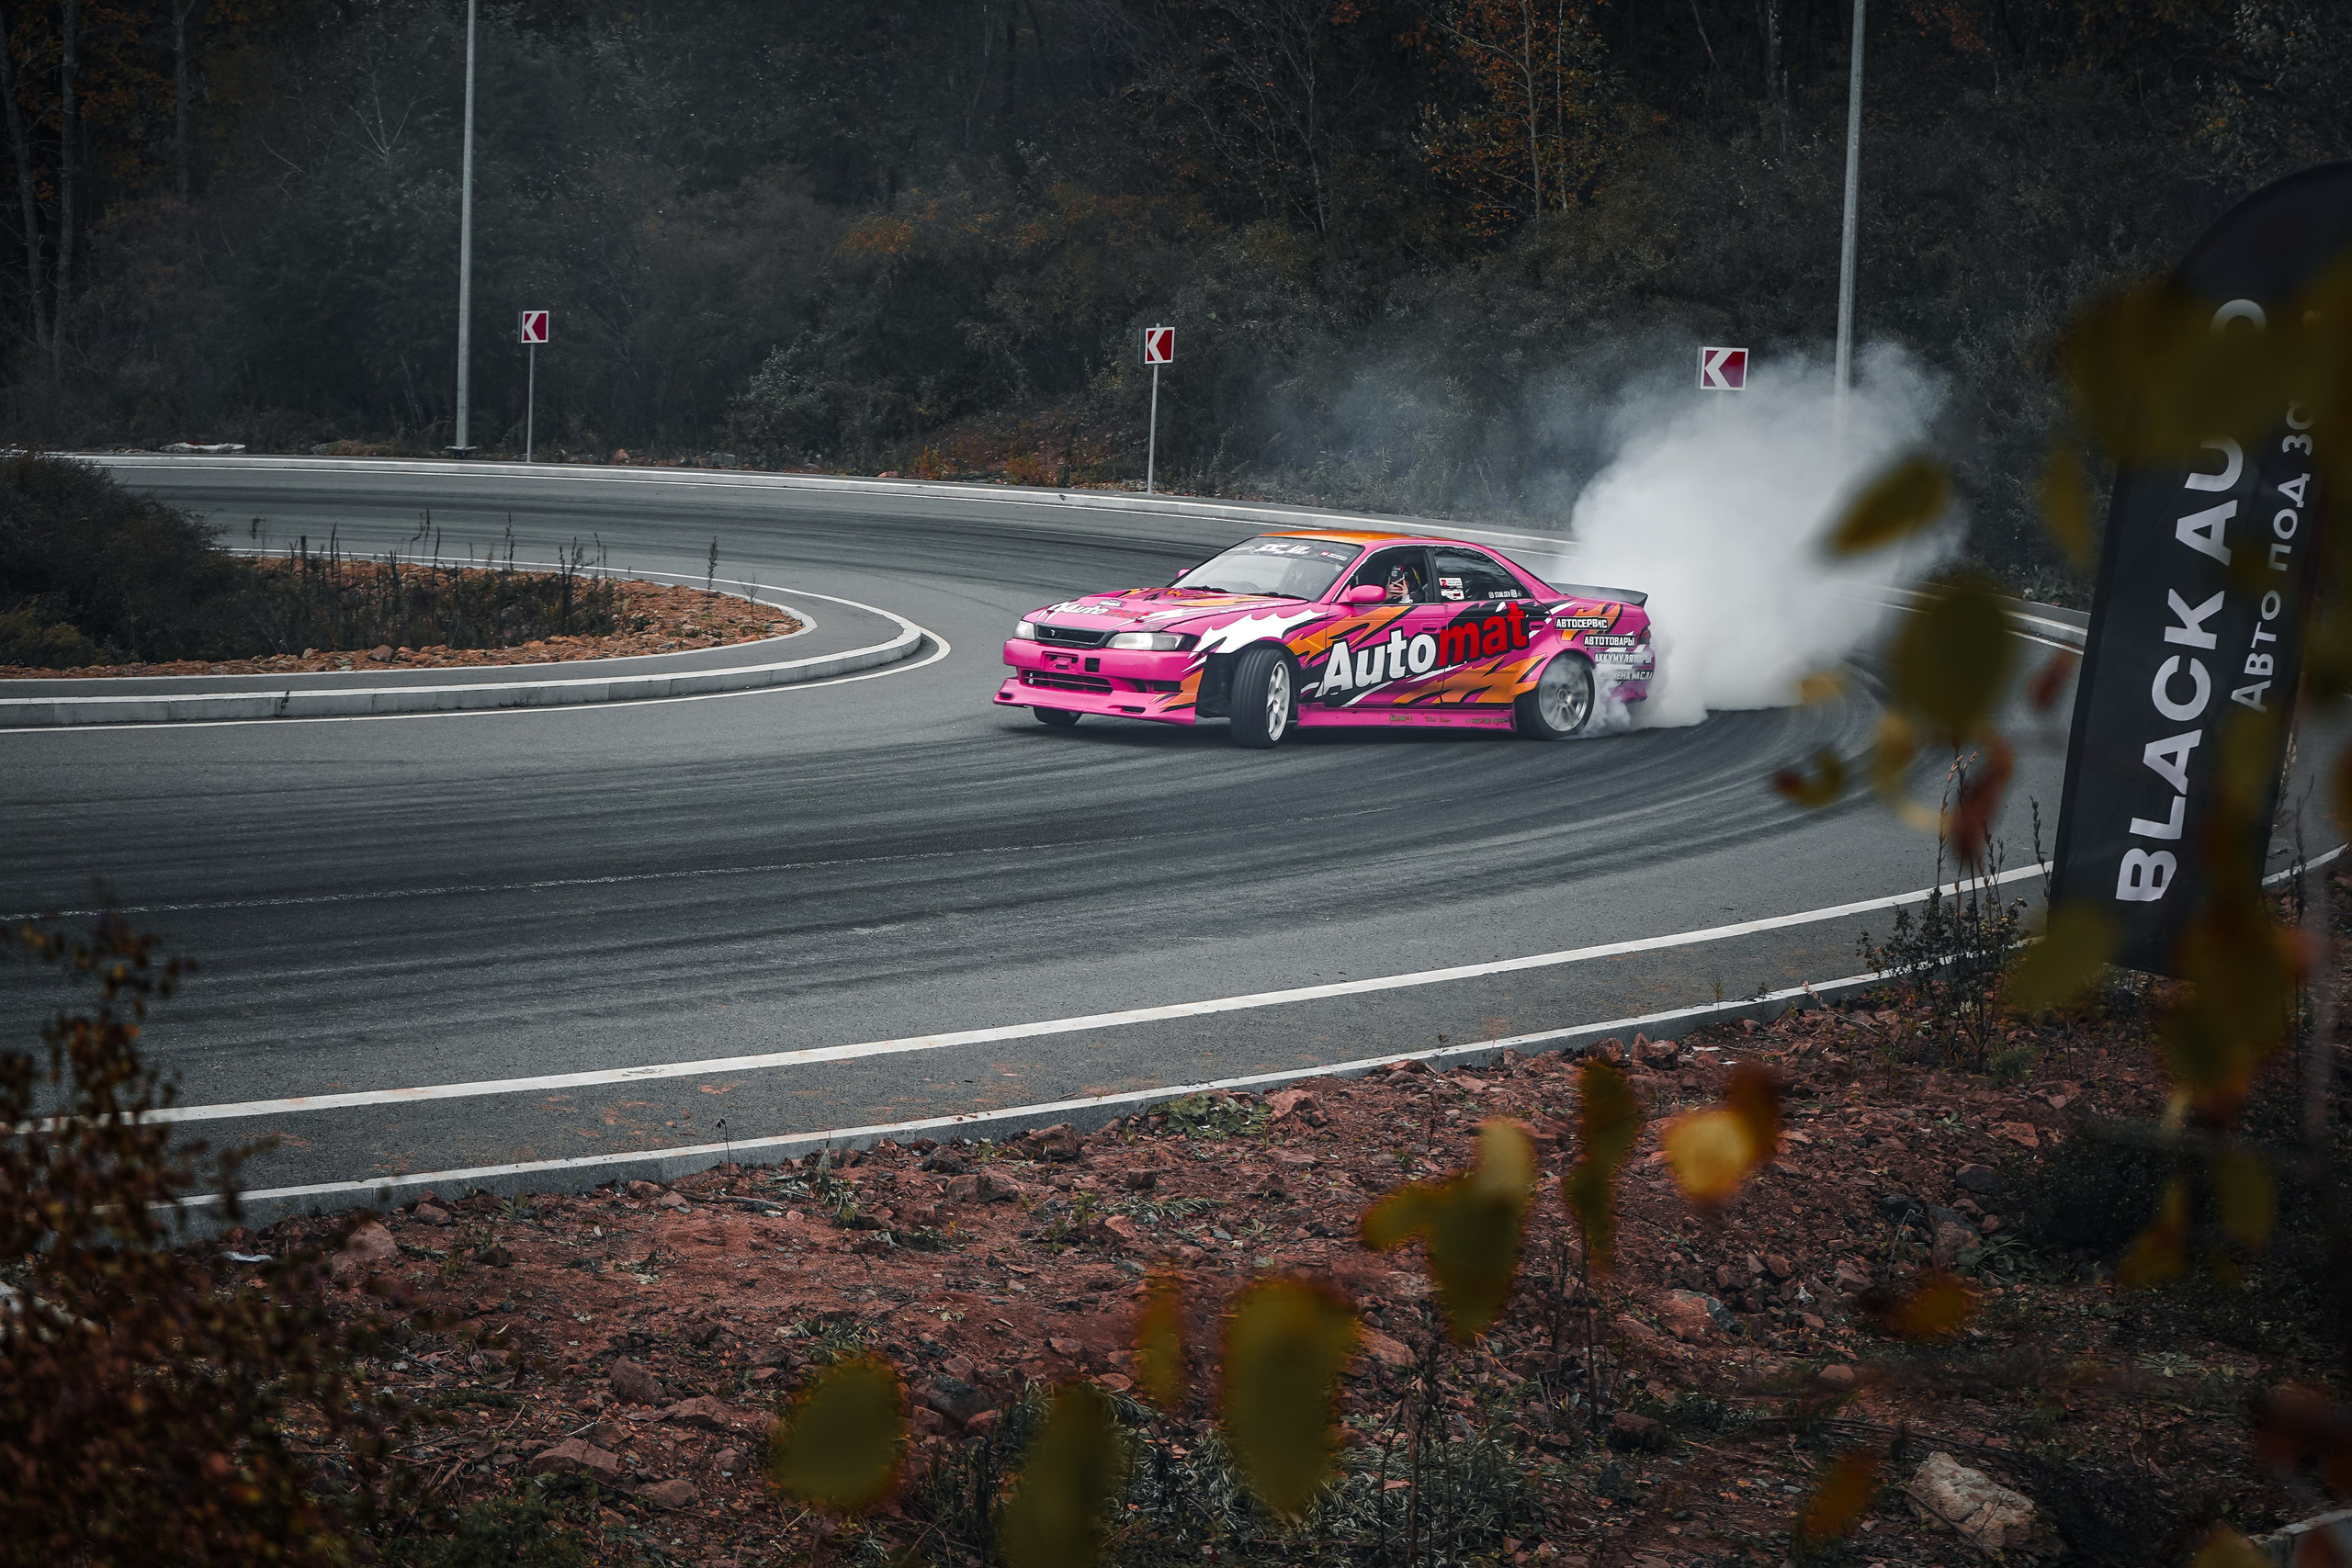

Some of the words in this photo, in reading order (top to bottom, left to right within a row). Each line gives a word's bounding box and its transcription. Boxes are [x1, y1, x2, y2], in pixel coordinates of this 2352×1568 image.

[1555, 618, 1608, 629] АВТОСЕРВИС
[2115, 588, 2226, 902] BLACK
[2175, 299, 2267, 567] AUO
[1315, 602, 1529, 694] Automat
[1584, 636, 1635, 647] АВТОТОВАРЫ
